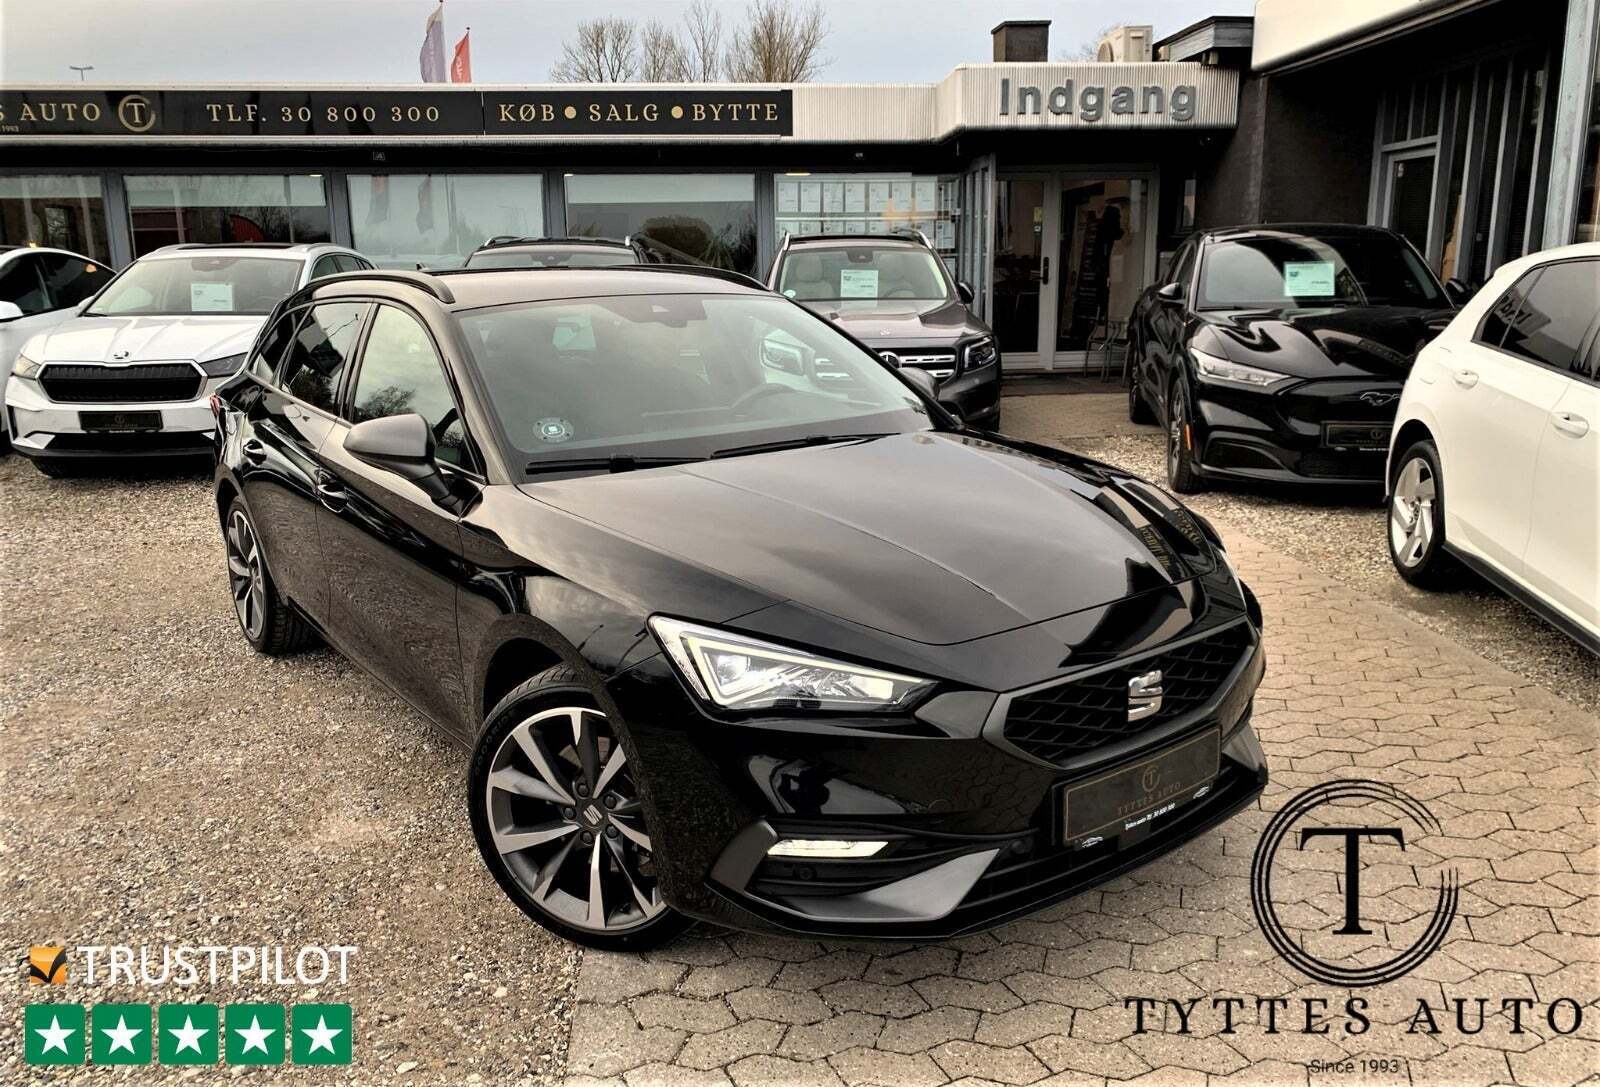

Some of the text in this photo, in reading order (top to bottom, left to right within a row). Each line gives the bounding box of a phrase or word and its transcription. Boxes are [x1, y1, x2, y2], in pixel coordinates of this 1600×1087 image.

[1000, 78, 1196, 122] Indgang
[20, 103, 101, 121] AUTO
[206, 104, 440, 122] TLF. 30 800 300
[499, 103, 779, 122] KØB SALG BYTTE
